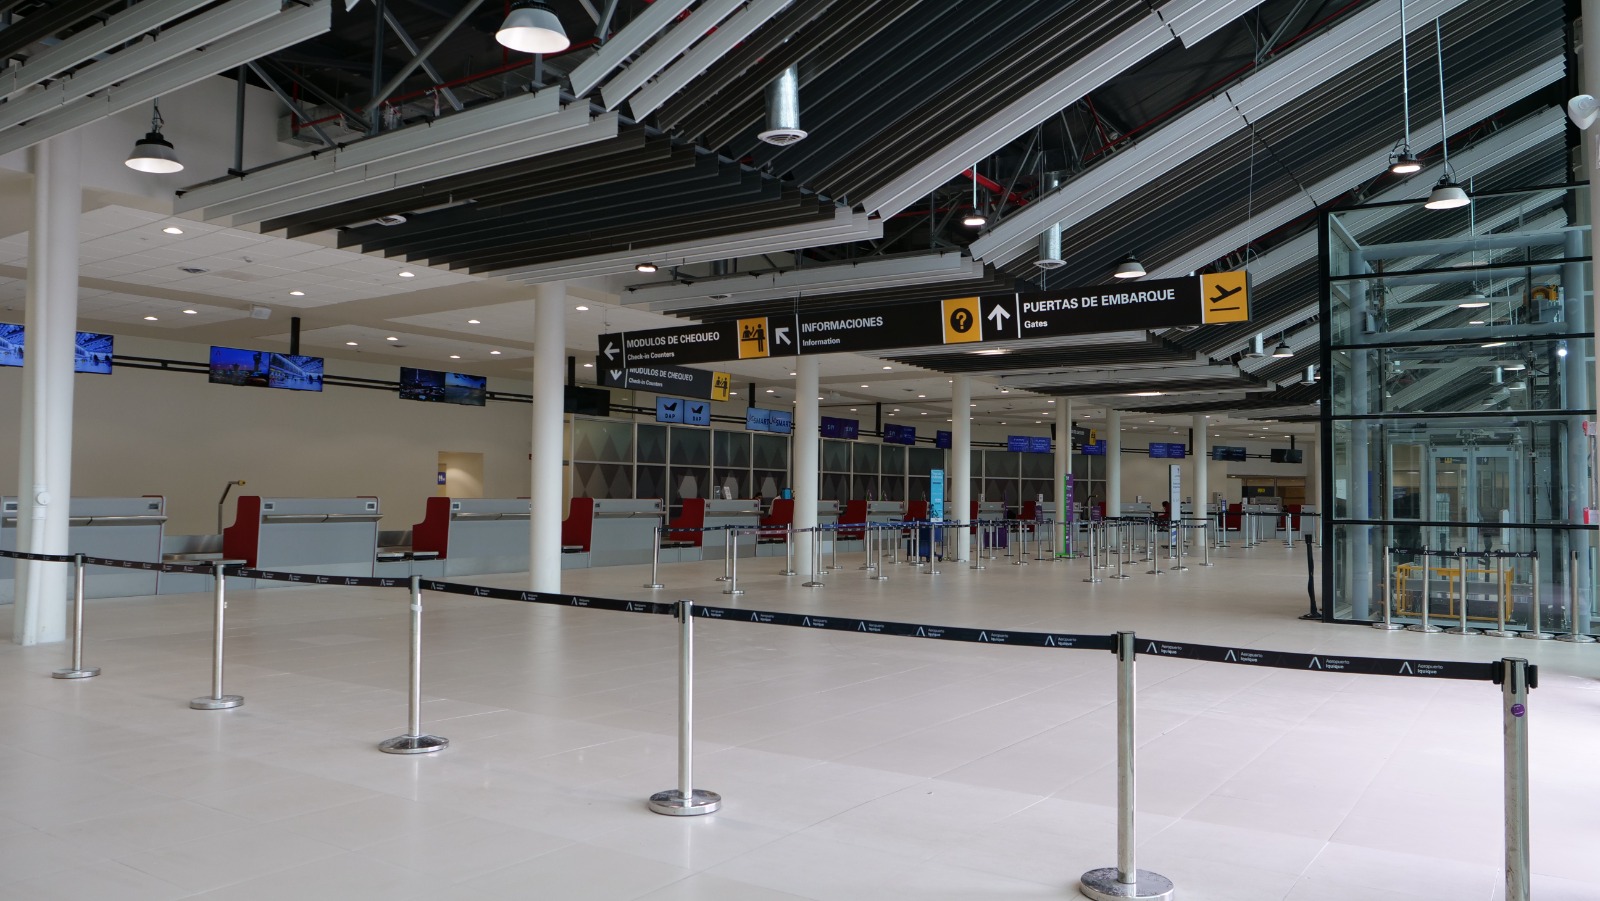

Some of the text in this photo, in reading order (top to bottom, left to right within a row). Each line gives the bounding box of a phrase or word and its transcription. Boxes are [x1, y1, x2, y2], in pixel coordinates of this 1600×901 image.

[1023, 288, 1176, 314] PUERTAS DE EMBARQUE
[801, 316, 884, 333] INFORMACIONES
[1024, 320, 1048, 329] Gates
[626, 331, 721, 349] MODULOS DE CHEQUEO
[802, 337, 841, 347] Information
[627, 351, 675, 361] Check-in Counters
[659, 370, 668, 378] DE
[667, 371, 694, 382] CHEQUEO
